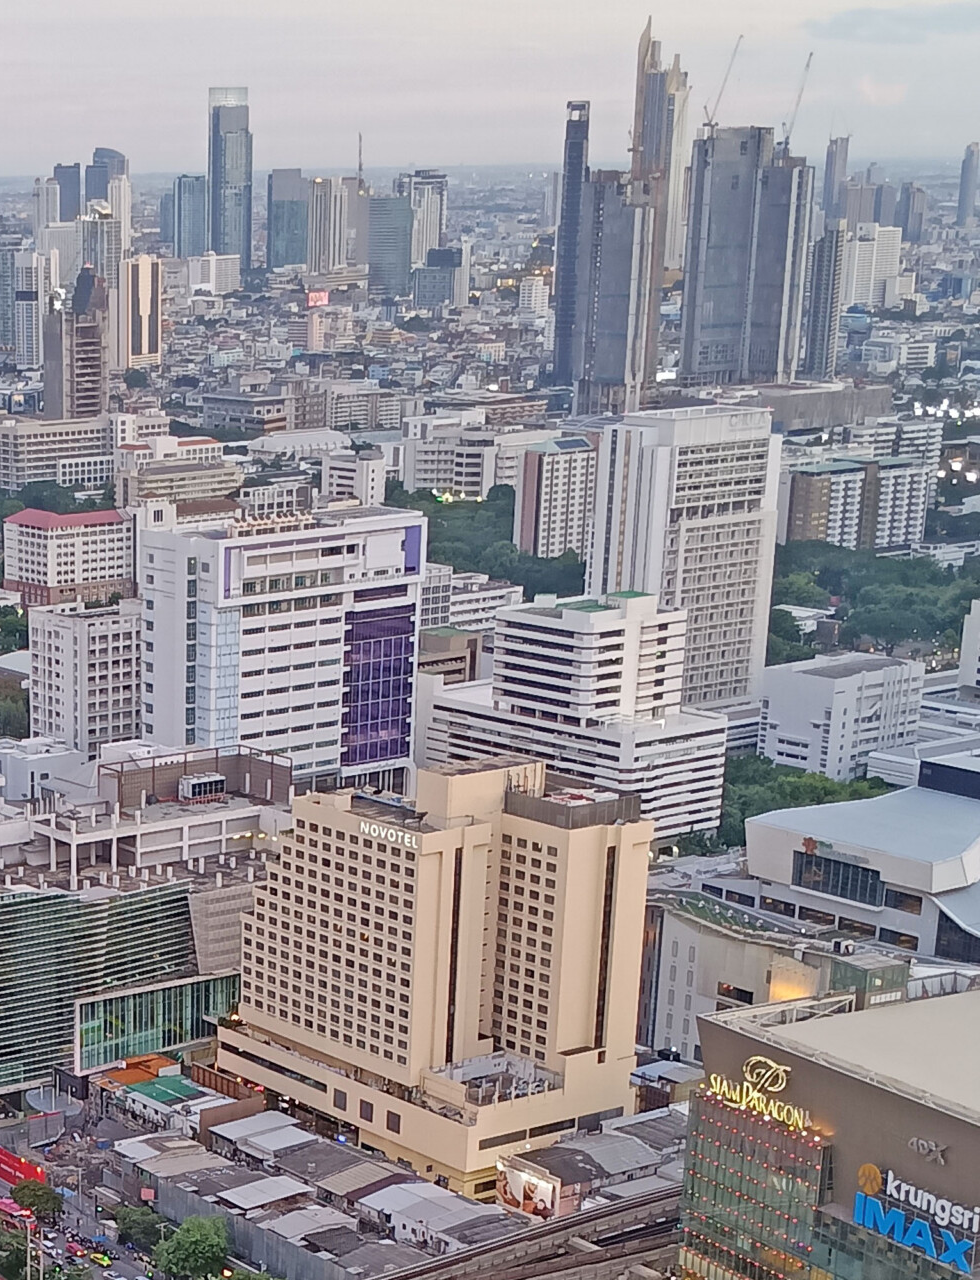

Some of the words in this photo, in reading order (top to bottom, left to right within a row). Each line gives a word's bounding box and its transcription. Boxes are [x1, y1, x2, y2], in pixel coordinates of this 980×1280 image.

[360, 820, 418, 849] NOVOTEL
[709, 1073, 741, 1103] SIAM
[742, 1081, 804, 1131] PARAGON
[908, 1137, 948, 1166] 4DX
[886, 1169, 980, 1233] krungsri
[854, 1191, 974, 1274] IMAX
